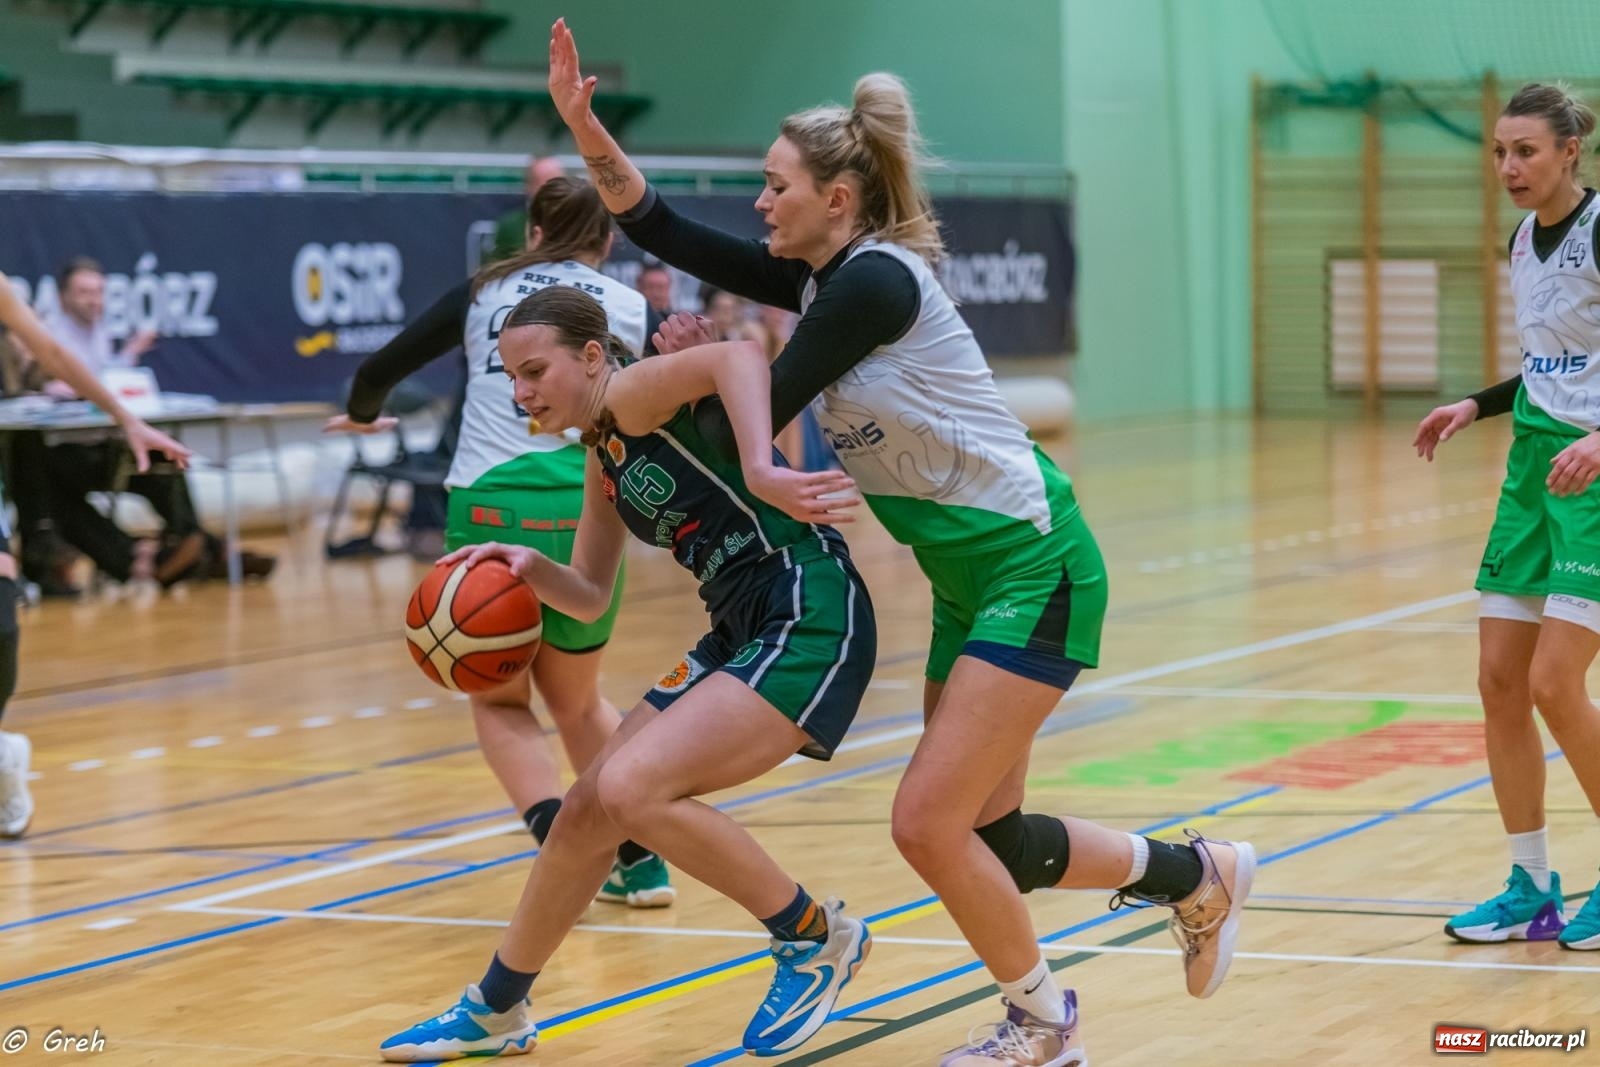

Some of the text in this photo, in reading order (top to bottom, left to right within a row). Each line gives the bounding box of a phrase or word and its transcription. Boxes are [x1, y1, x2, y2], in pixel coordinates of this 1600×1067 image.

[1559, 238, 1586, 268] 14
[523, 272, 560, 286] RKK
[5, 252, 219, 337] ABÓRZ
[620, 454, 676, 519] 15
[724, 531, 756, 556] ŚL.
